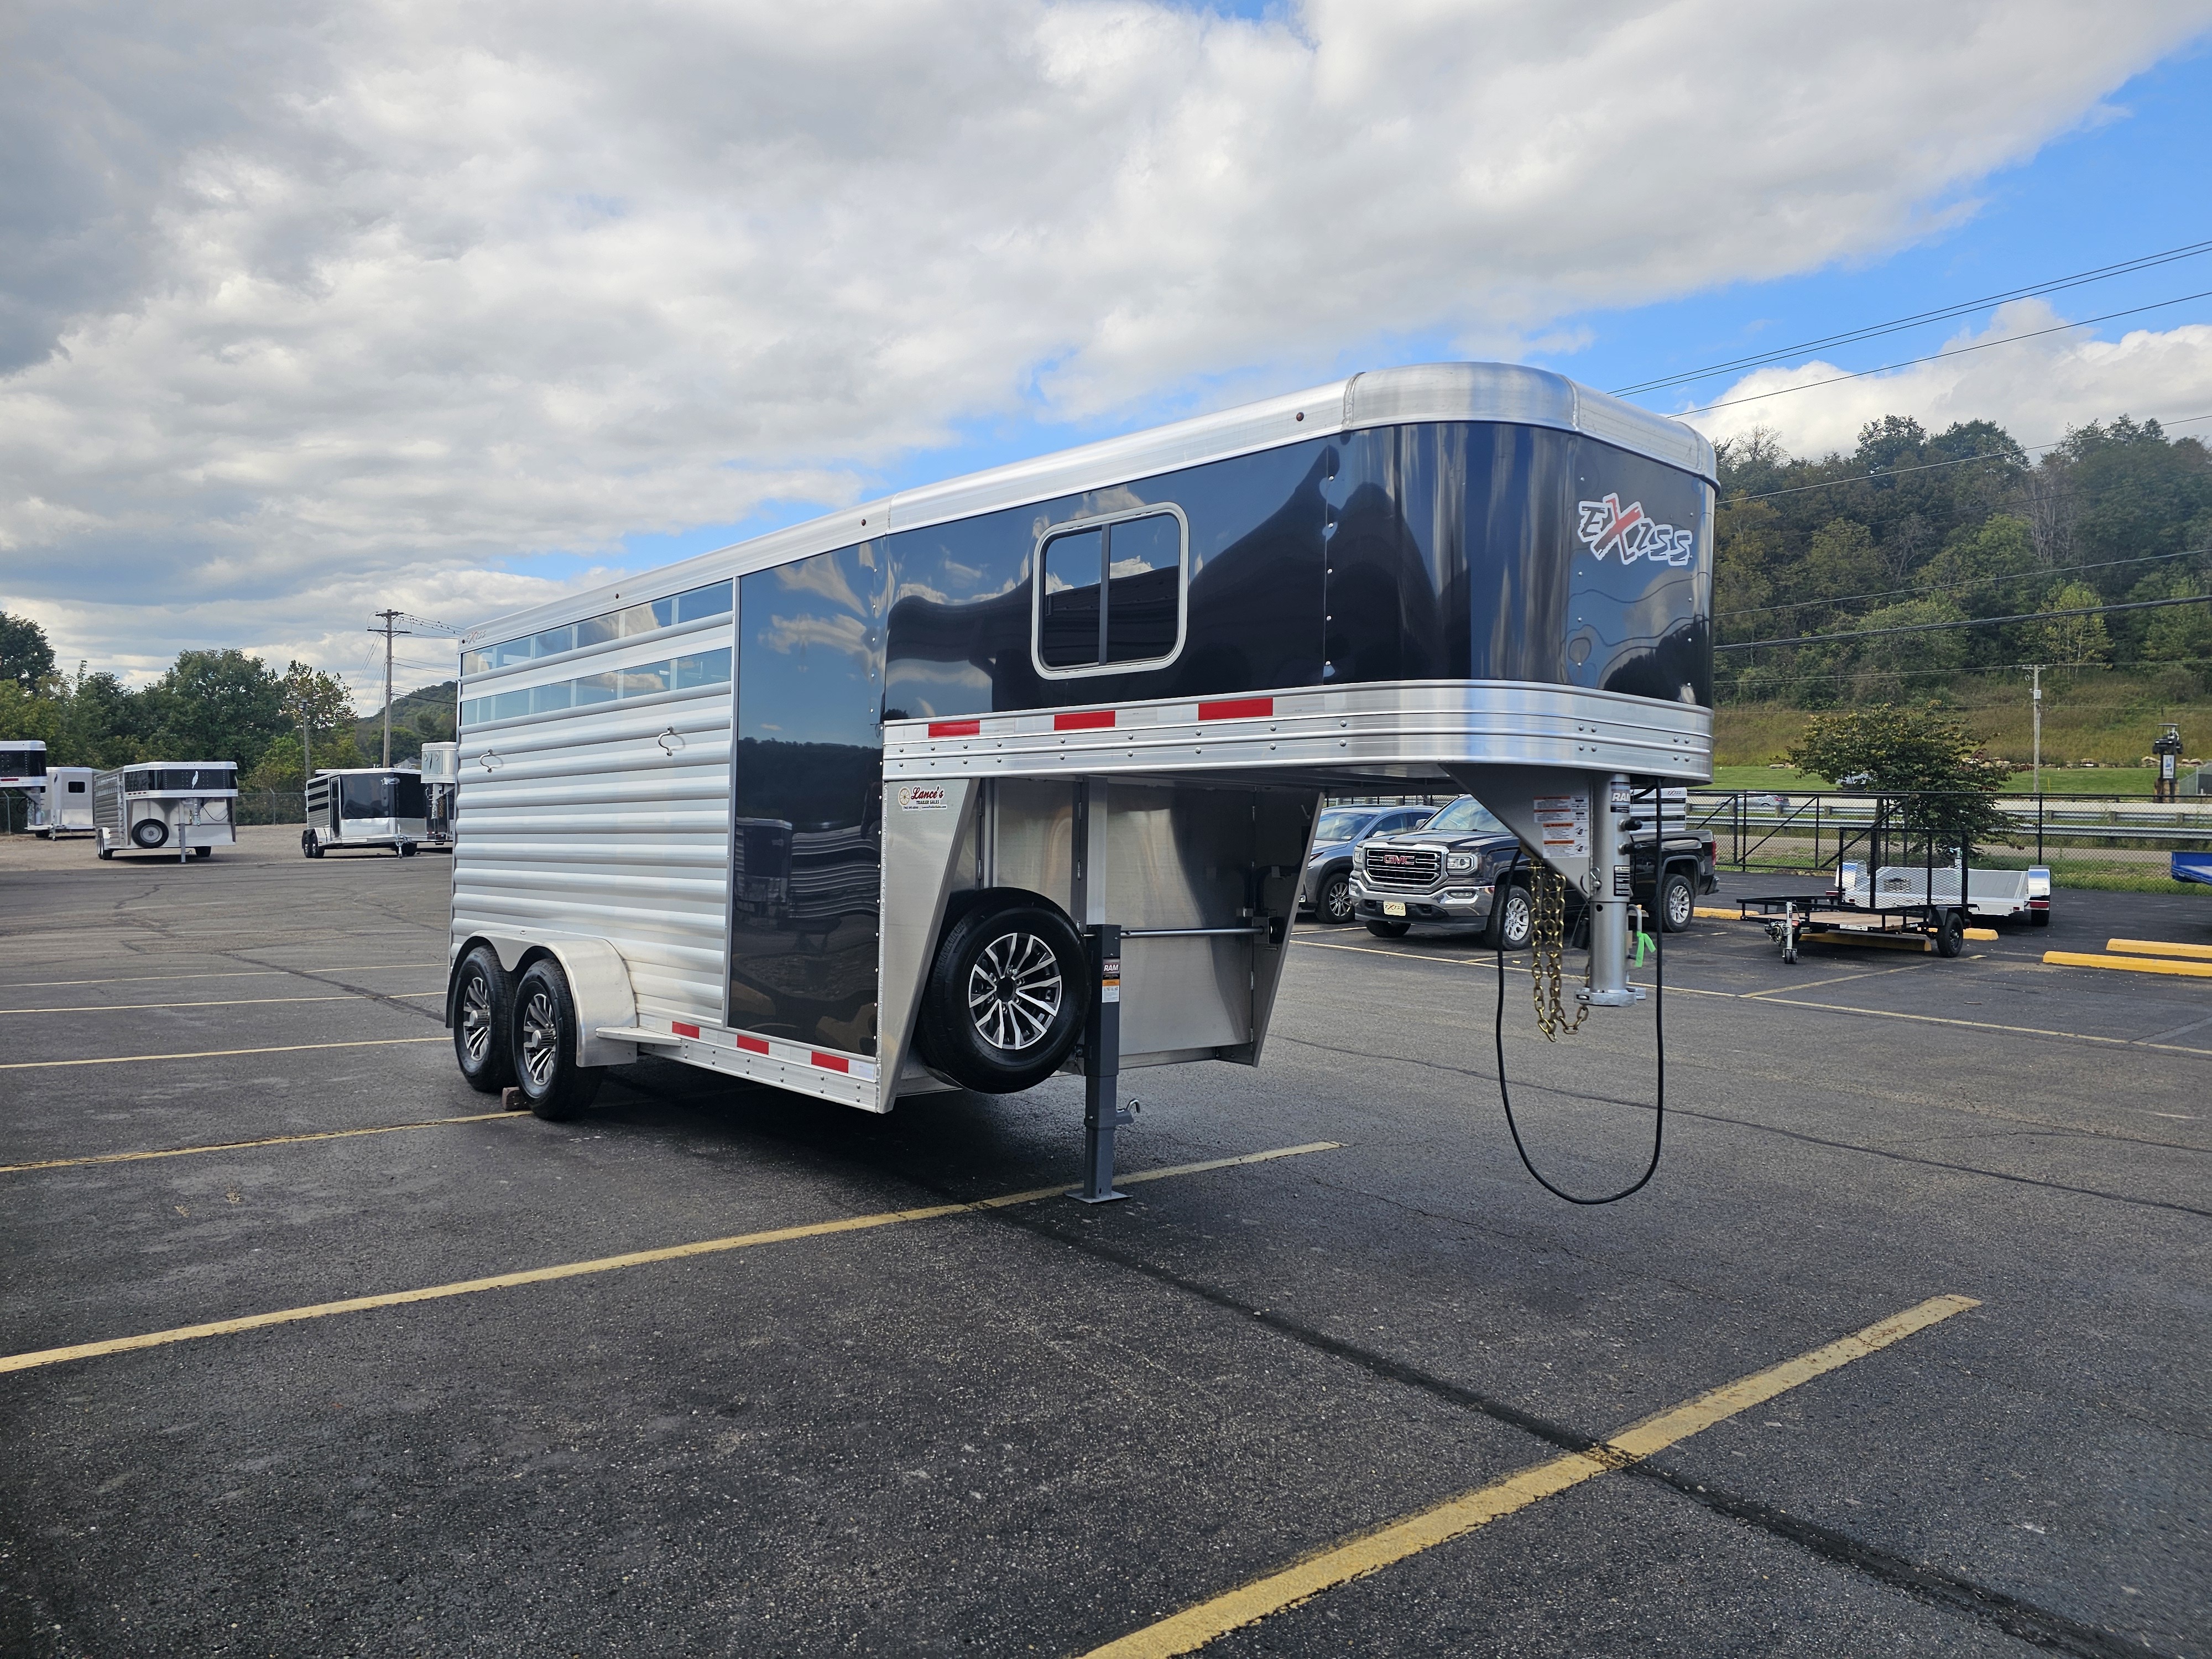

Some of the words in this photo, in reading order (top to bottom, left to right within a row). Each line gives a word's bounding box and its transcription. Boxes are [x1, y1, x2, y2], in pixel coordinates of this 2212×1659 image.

[1578, 493, 1692, 566] EXISS
[911, 786, 943, 800] Lance's
[1384, 854, 1415, 865] GMC
